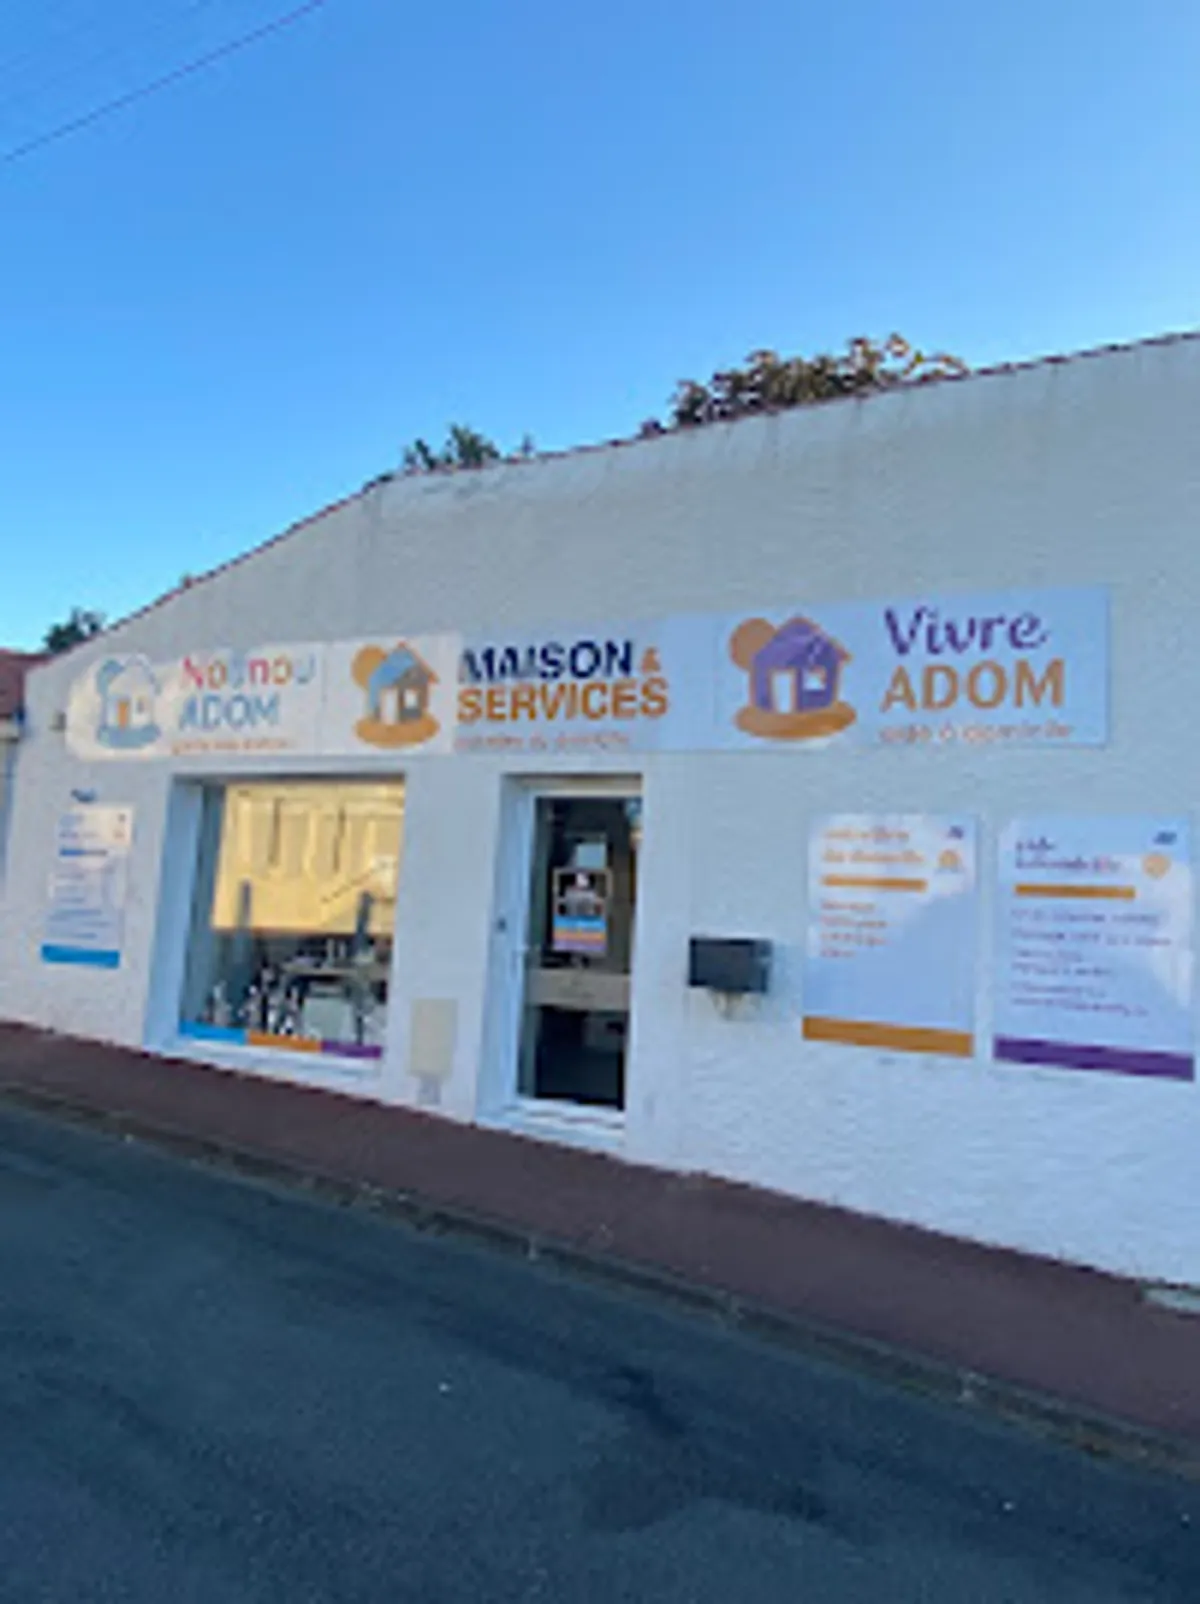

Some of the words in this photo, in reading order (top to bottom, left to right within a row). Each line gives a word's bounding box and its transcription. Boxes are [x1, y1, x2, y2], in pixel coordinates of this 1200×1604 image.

[884, 605, 1049, 655] Vivre
[458, 639, 632, 683] MAISON
[457, 678, 669, 725] SERVICES
[880, 658, 1066, 713] ADOM
[178, 693, 281, 731] ADOM
